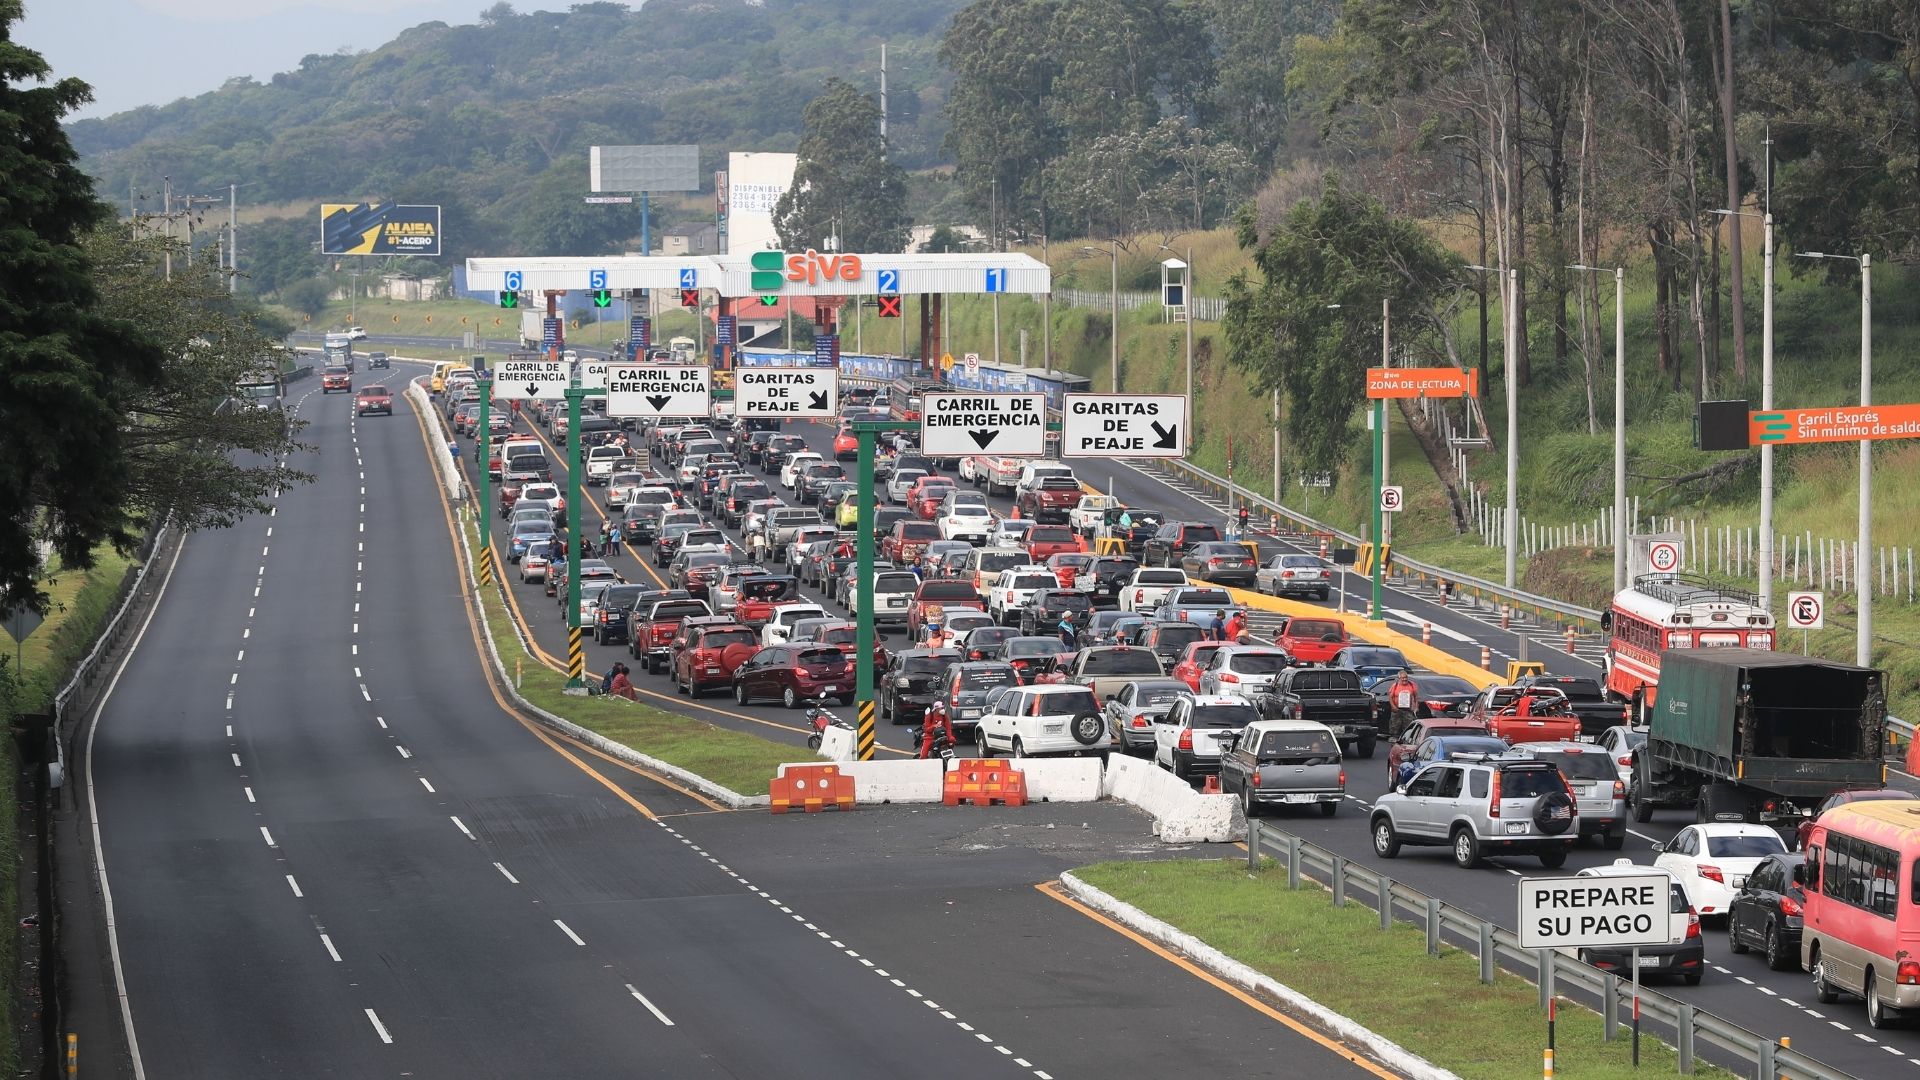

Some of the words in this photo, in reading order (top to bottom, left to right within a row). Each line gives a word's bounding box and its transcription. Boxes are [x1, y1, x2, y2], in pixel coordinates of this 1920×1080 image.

[787, 250, 861, 286] siva
[506, 271, 521, 290] 6
[591, 272, 604, 288] 5
[681, 270, 695, 286] 4
[880, 270, 896, 293] 2
[989, 269, 1002, 292] 1
[505, 363, 542, 372] CARRIL
[546, 363, 560, 372] DE
[499, 373, 566, 382] EMERGENCIA
[618, 370, 672, 380] CARRIL
[680, 370, 699, 380] DE
[742, 374, 815, 384] GARITAS
[610, 383, 706, 393] EMERGENCIA
[1370, 381, 1399, 389] ZONA
[1401, 381, 1415, 389] DE
[1416, 380, 1461, 389] LECTURA
[768, 388, 789, 397] DE
[747, 402, 800, 411] PEAJE
[936, 399, 1000, 411] CARRIL
[1010, 398, 1033, 411] DE
[1072, 403, 1159, 415] GARITAS
[926, 414, 1041, 426] EMERGENCIA
[1798, 413, 1832, 426] Carril
[1836, 410, 1879, 427] Exprés
[1103, 420, 1129, 432] DE
[1798, 426, 1818, 438] Sin
[1821, 424, 1869, 437] mínimo
[1872, 422, 1887, 434] de
[1081, 438, 1144, 450] PEAJE
[1658, 549, 1669, 559] 25
[1535, 886, 1654, 909] PREPARE
[1537, 916, 1571, 936] SU
[1580, 913, 1653, 935] PAGO
